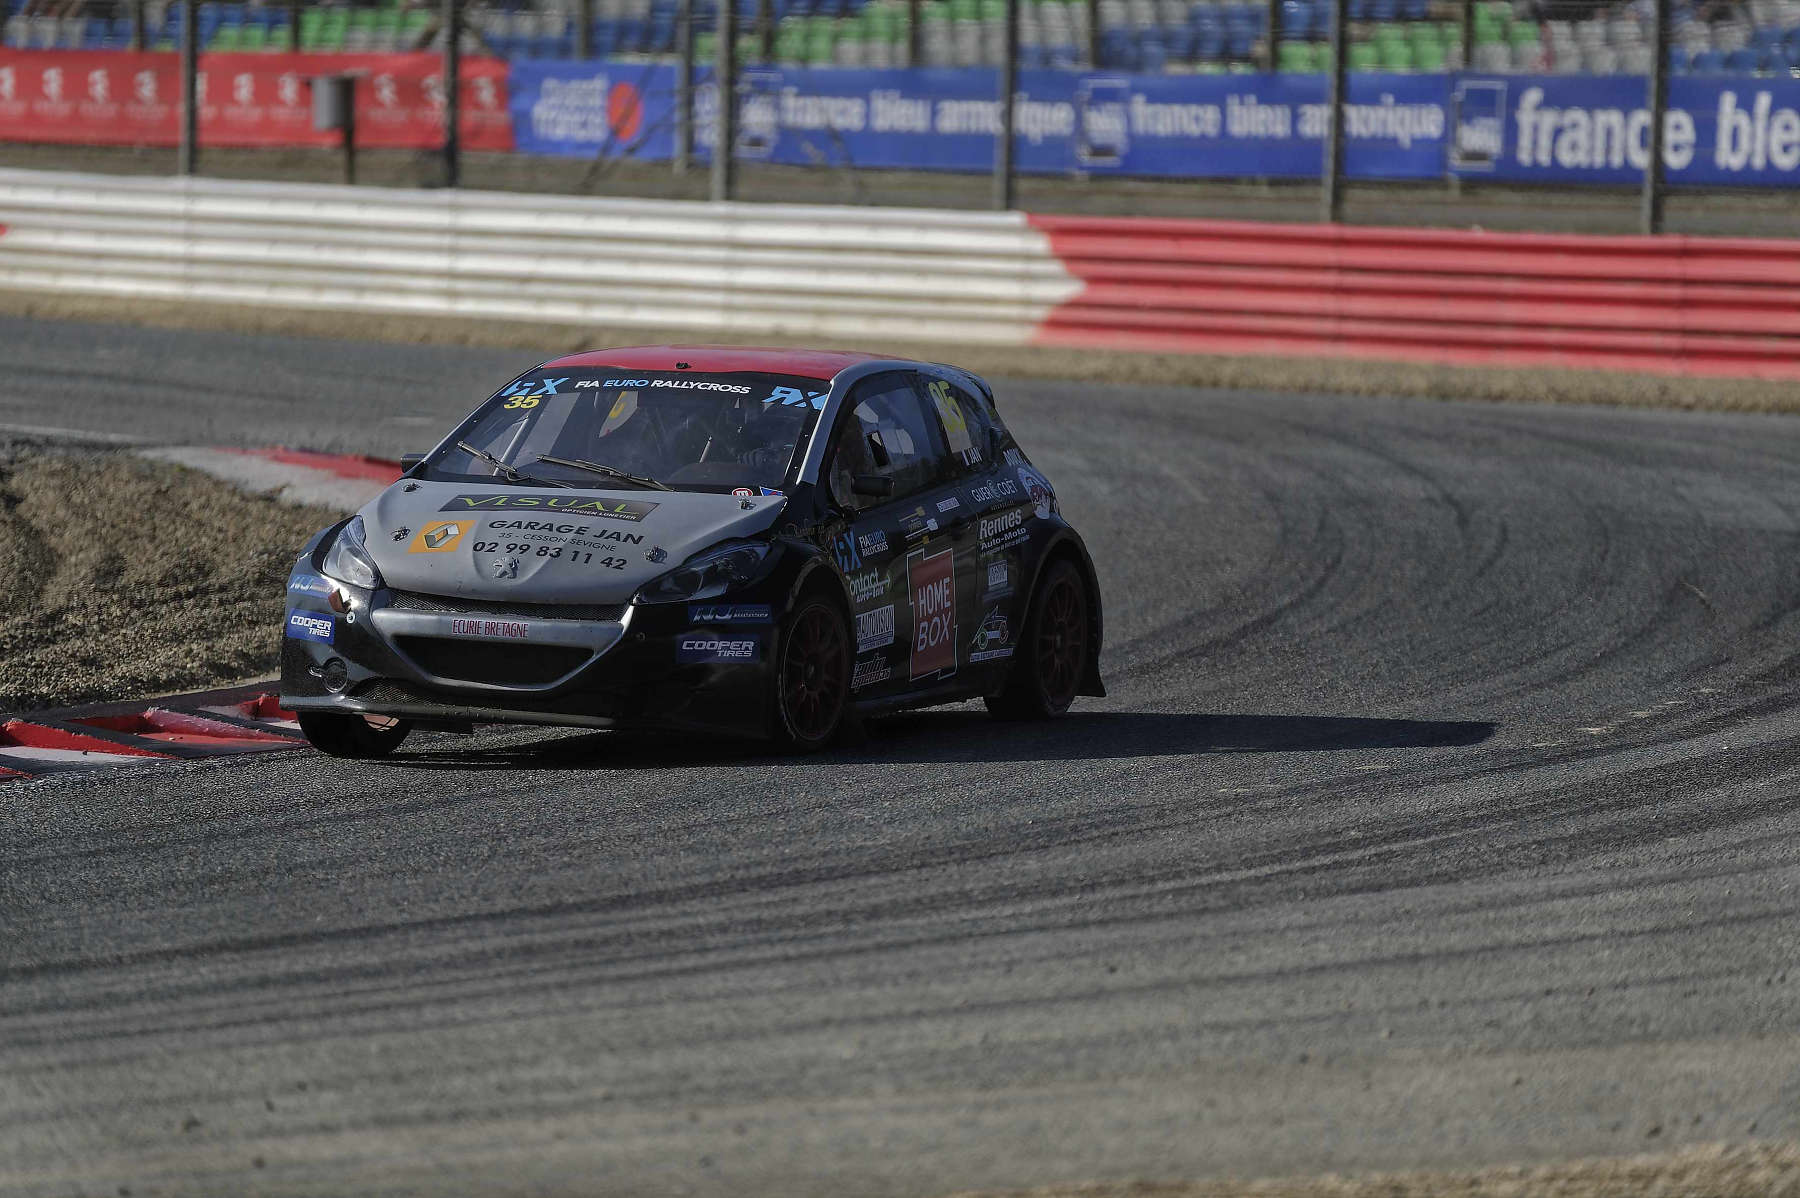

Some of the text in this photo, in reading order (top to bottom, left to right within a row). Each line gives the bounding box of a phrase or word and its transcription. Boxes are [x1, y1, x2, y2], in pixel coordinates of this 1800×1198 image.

[780, 86, 867, 132] france
[870, 88, 931, 133] bleu
[1130, 93, 1221, 137] france
[1226, 93, 1292, 138] bleu
[1516, 86, 1696, 170] france
[575, 379, 752, 395] FIA EURO RALLYCROSS
[503, 394, 543, 409] 35
[458, 494, 640, 514] VISUAL
[489, 519, 645, 545] GARAGE JAN
[979, 509, 1022, 540] Rennes
[523, 532, 568, 543] CESSON
[570, 536, 617, 551] SEVIGNE
[980, 527, 1027, 551] Auto-Moto
[472, 542, 628, 570] 02 99 83 11 42
[846, 567, 879, 596] ontact
[918, 576, 952, 618] HOME
[291, 615, 332, 631] COOPER
[309, 627, 331, 638] TIRES
[452, 619, 529, 638] ECURIE BRETAGNE
[917, 611, 952, 652] BOX
[682, 640, 755, 651] COOPER
